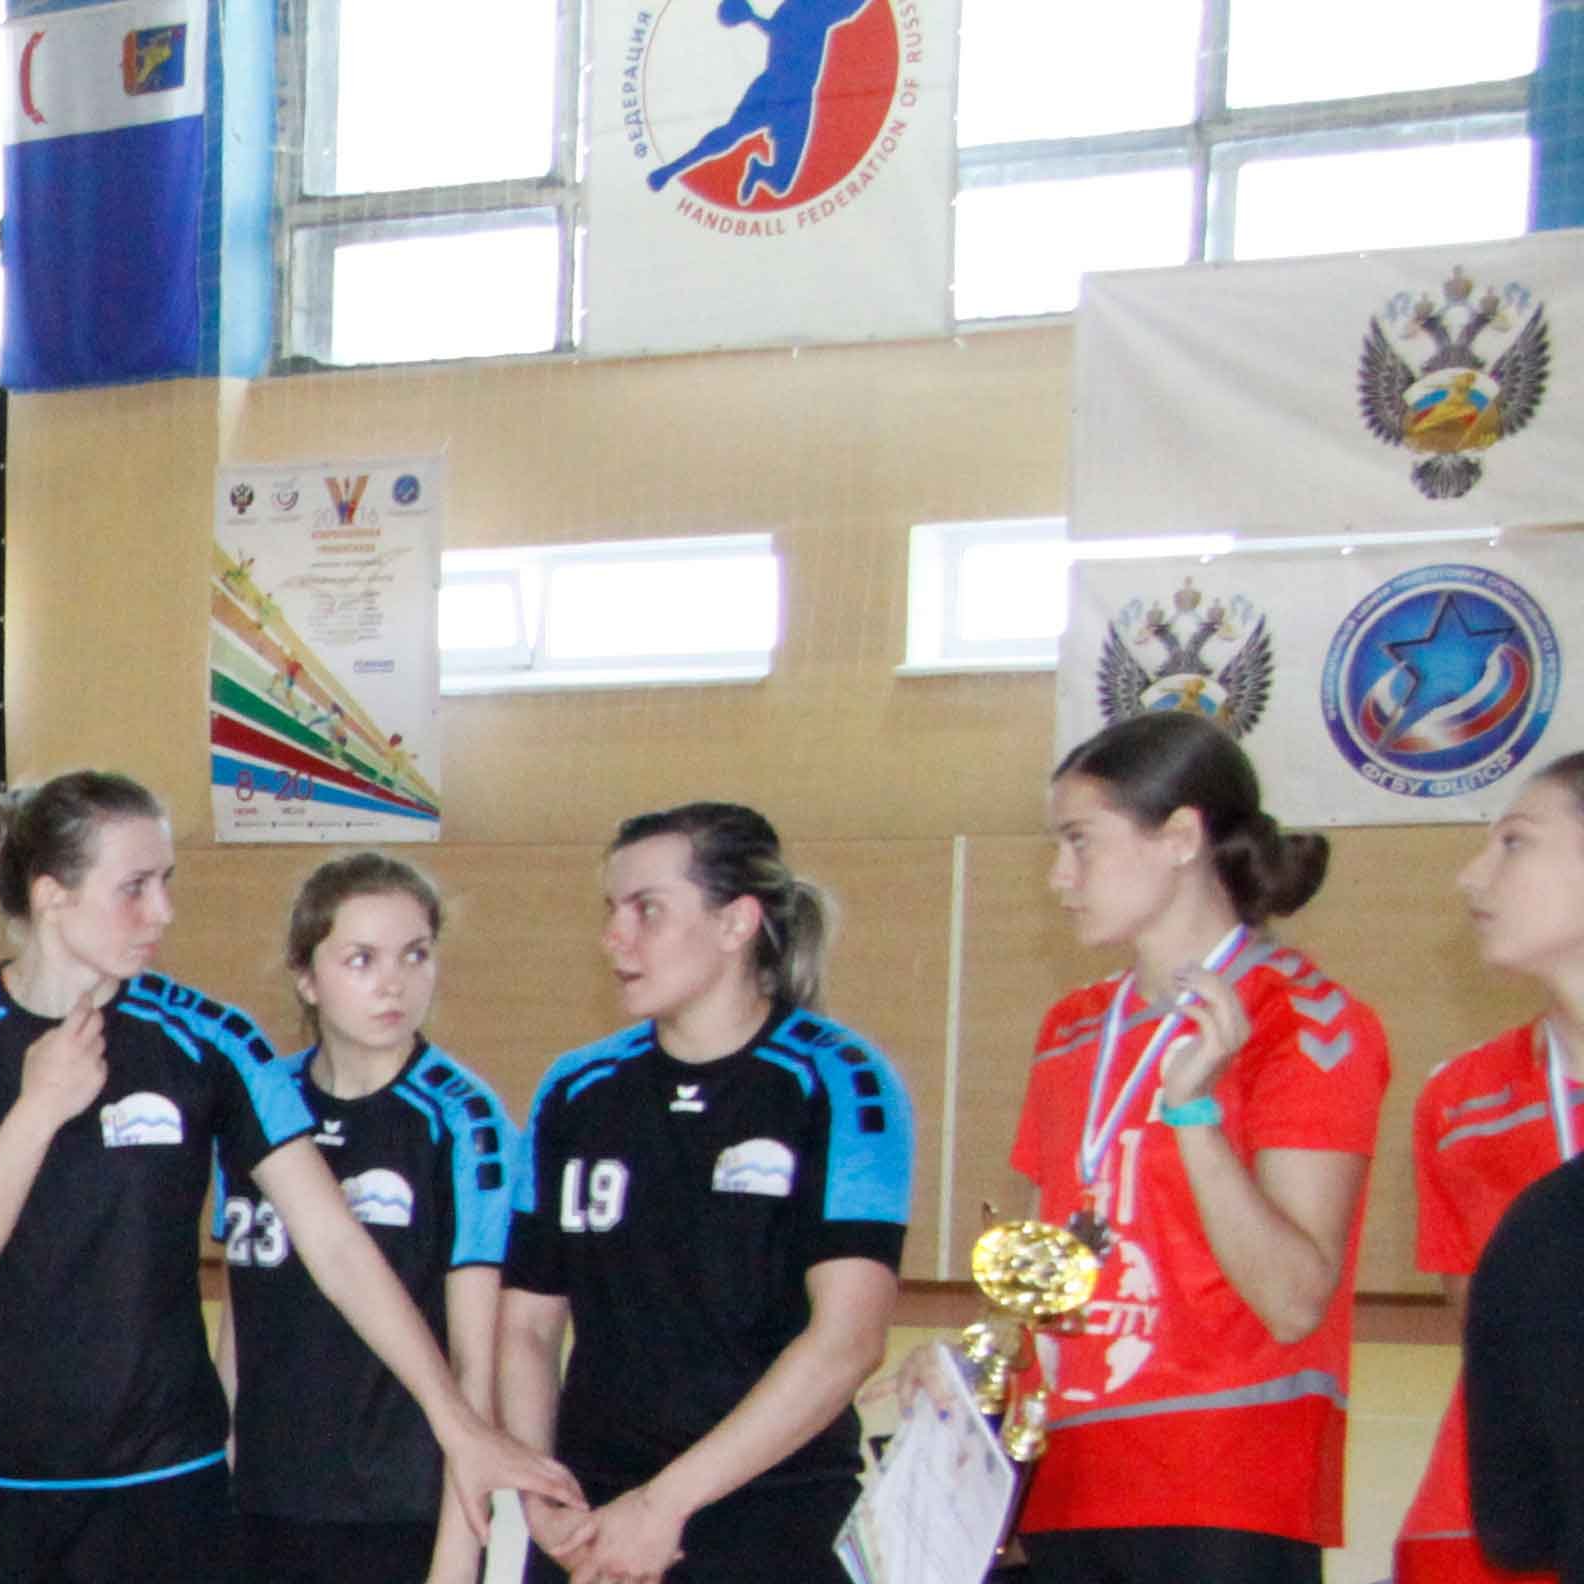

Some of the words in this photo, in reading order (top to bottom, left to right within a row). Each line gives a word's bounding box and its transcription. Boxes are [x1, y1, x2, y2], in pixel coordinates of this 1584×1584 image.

[898, 0, 920, 64] RUSS
[900, 79, 920, 108] OF
[797, 121, 907, 229] FEDERATION
[677, 196, 786, 237] HANDBALL
[224, 1196, 289, 1268] 23
